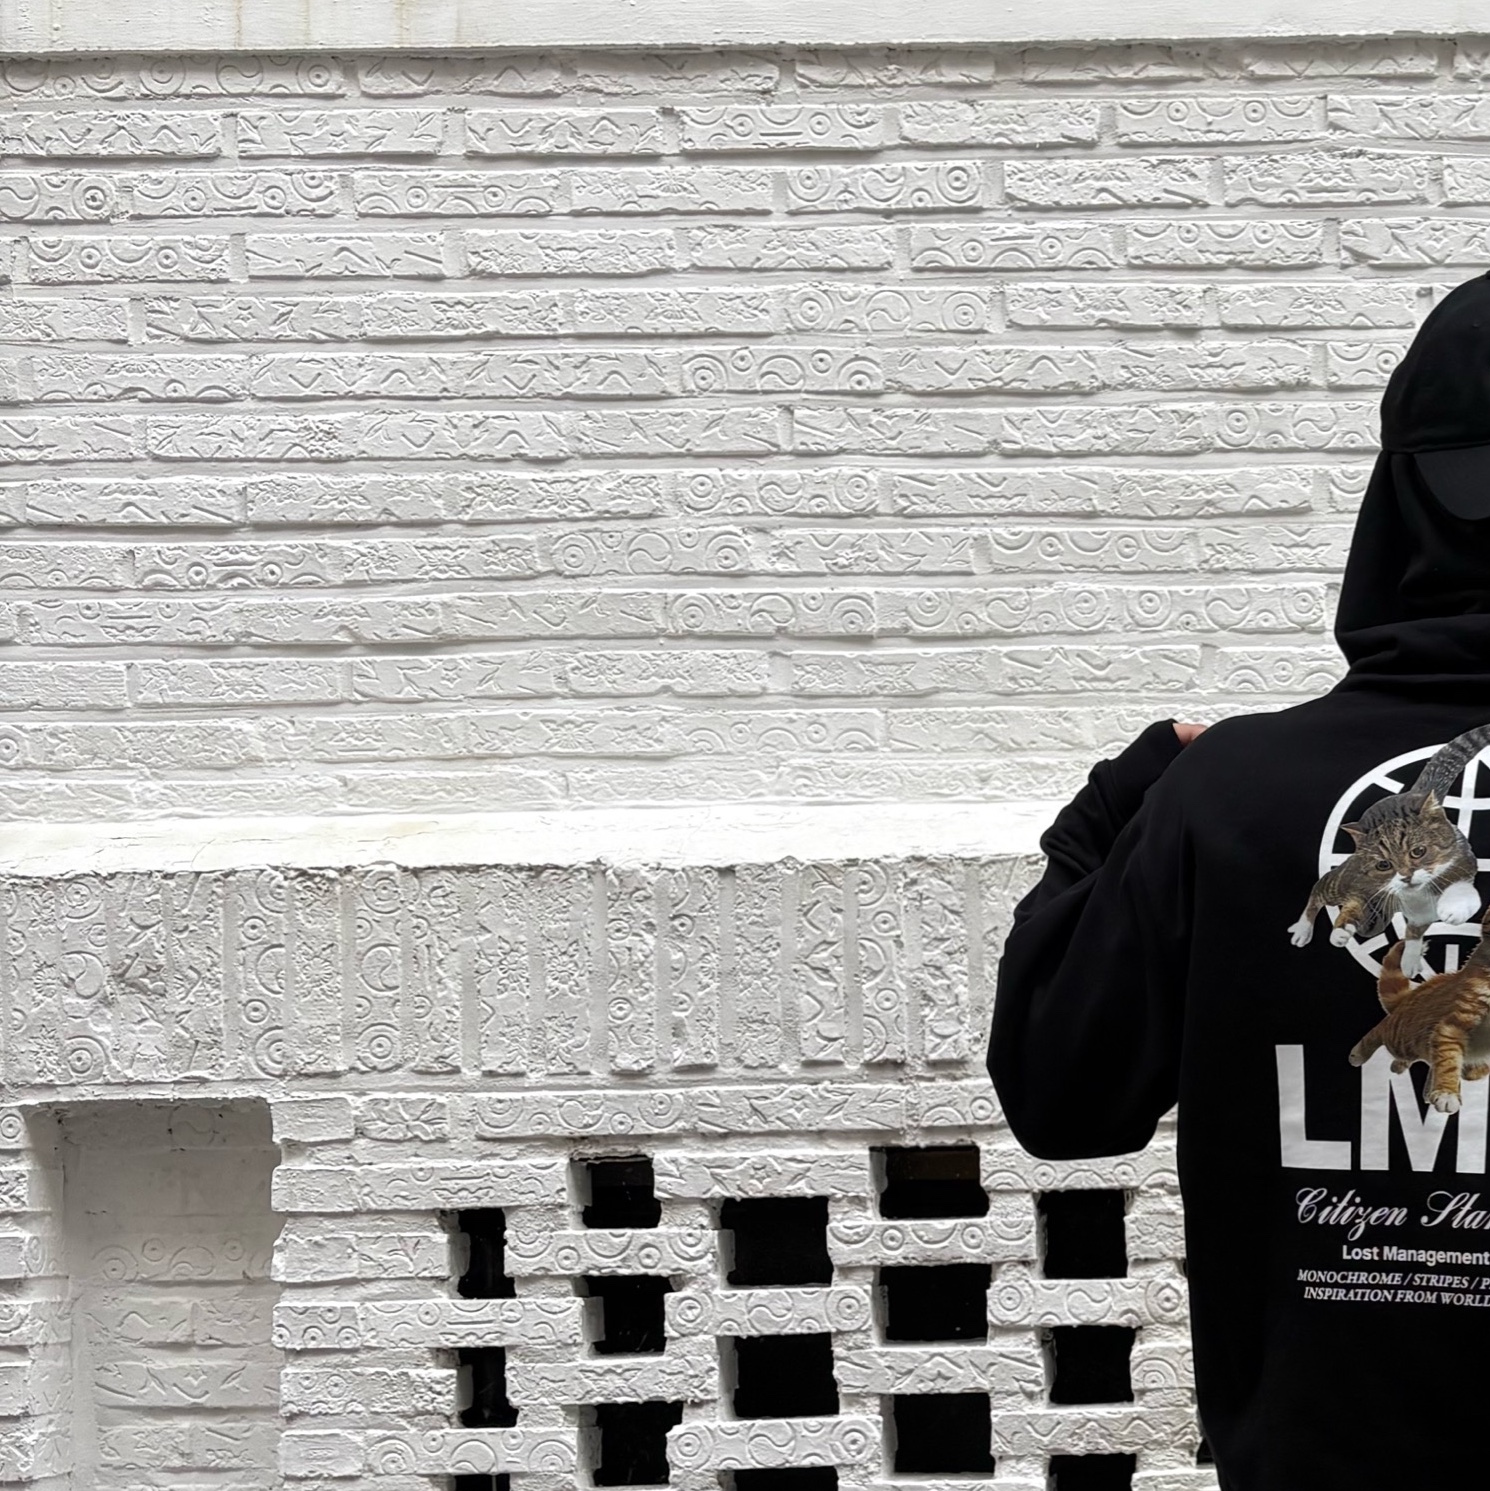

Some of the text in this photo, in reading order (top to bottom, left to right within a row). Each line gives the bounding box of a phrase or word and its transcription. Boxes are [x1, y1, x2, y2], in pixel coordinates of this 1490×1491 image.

[1295, 1187, 1408, 1242] Citizen
[1342, 1245, 1379, 1261] Lost
[1383, 1246, 1490, 1267] Management
[1297, 1269, 1403, 1286] MONOCHROME
[1412, 1273, 1470, 1289] STRIPES
[1303, 1286, 1395, 1302] INSPIRATION
[1395, 1289, 1439, 1304] FROM
